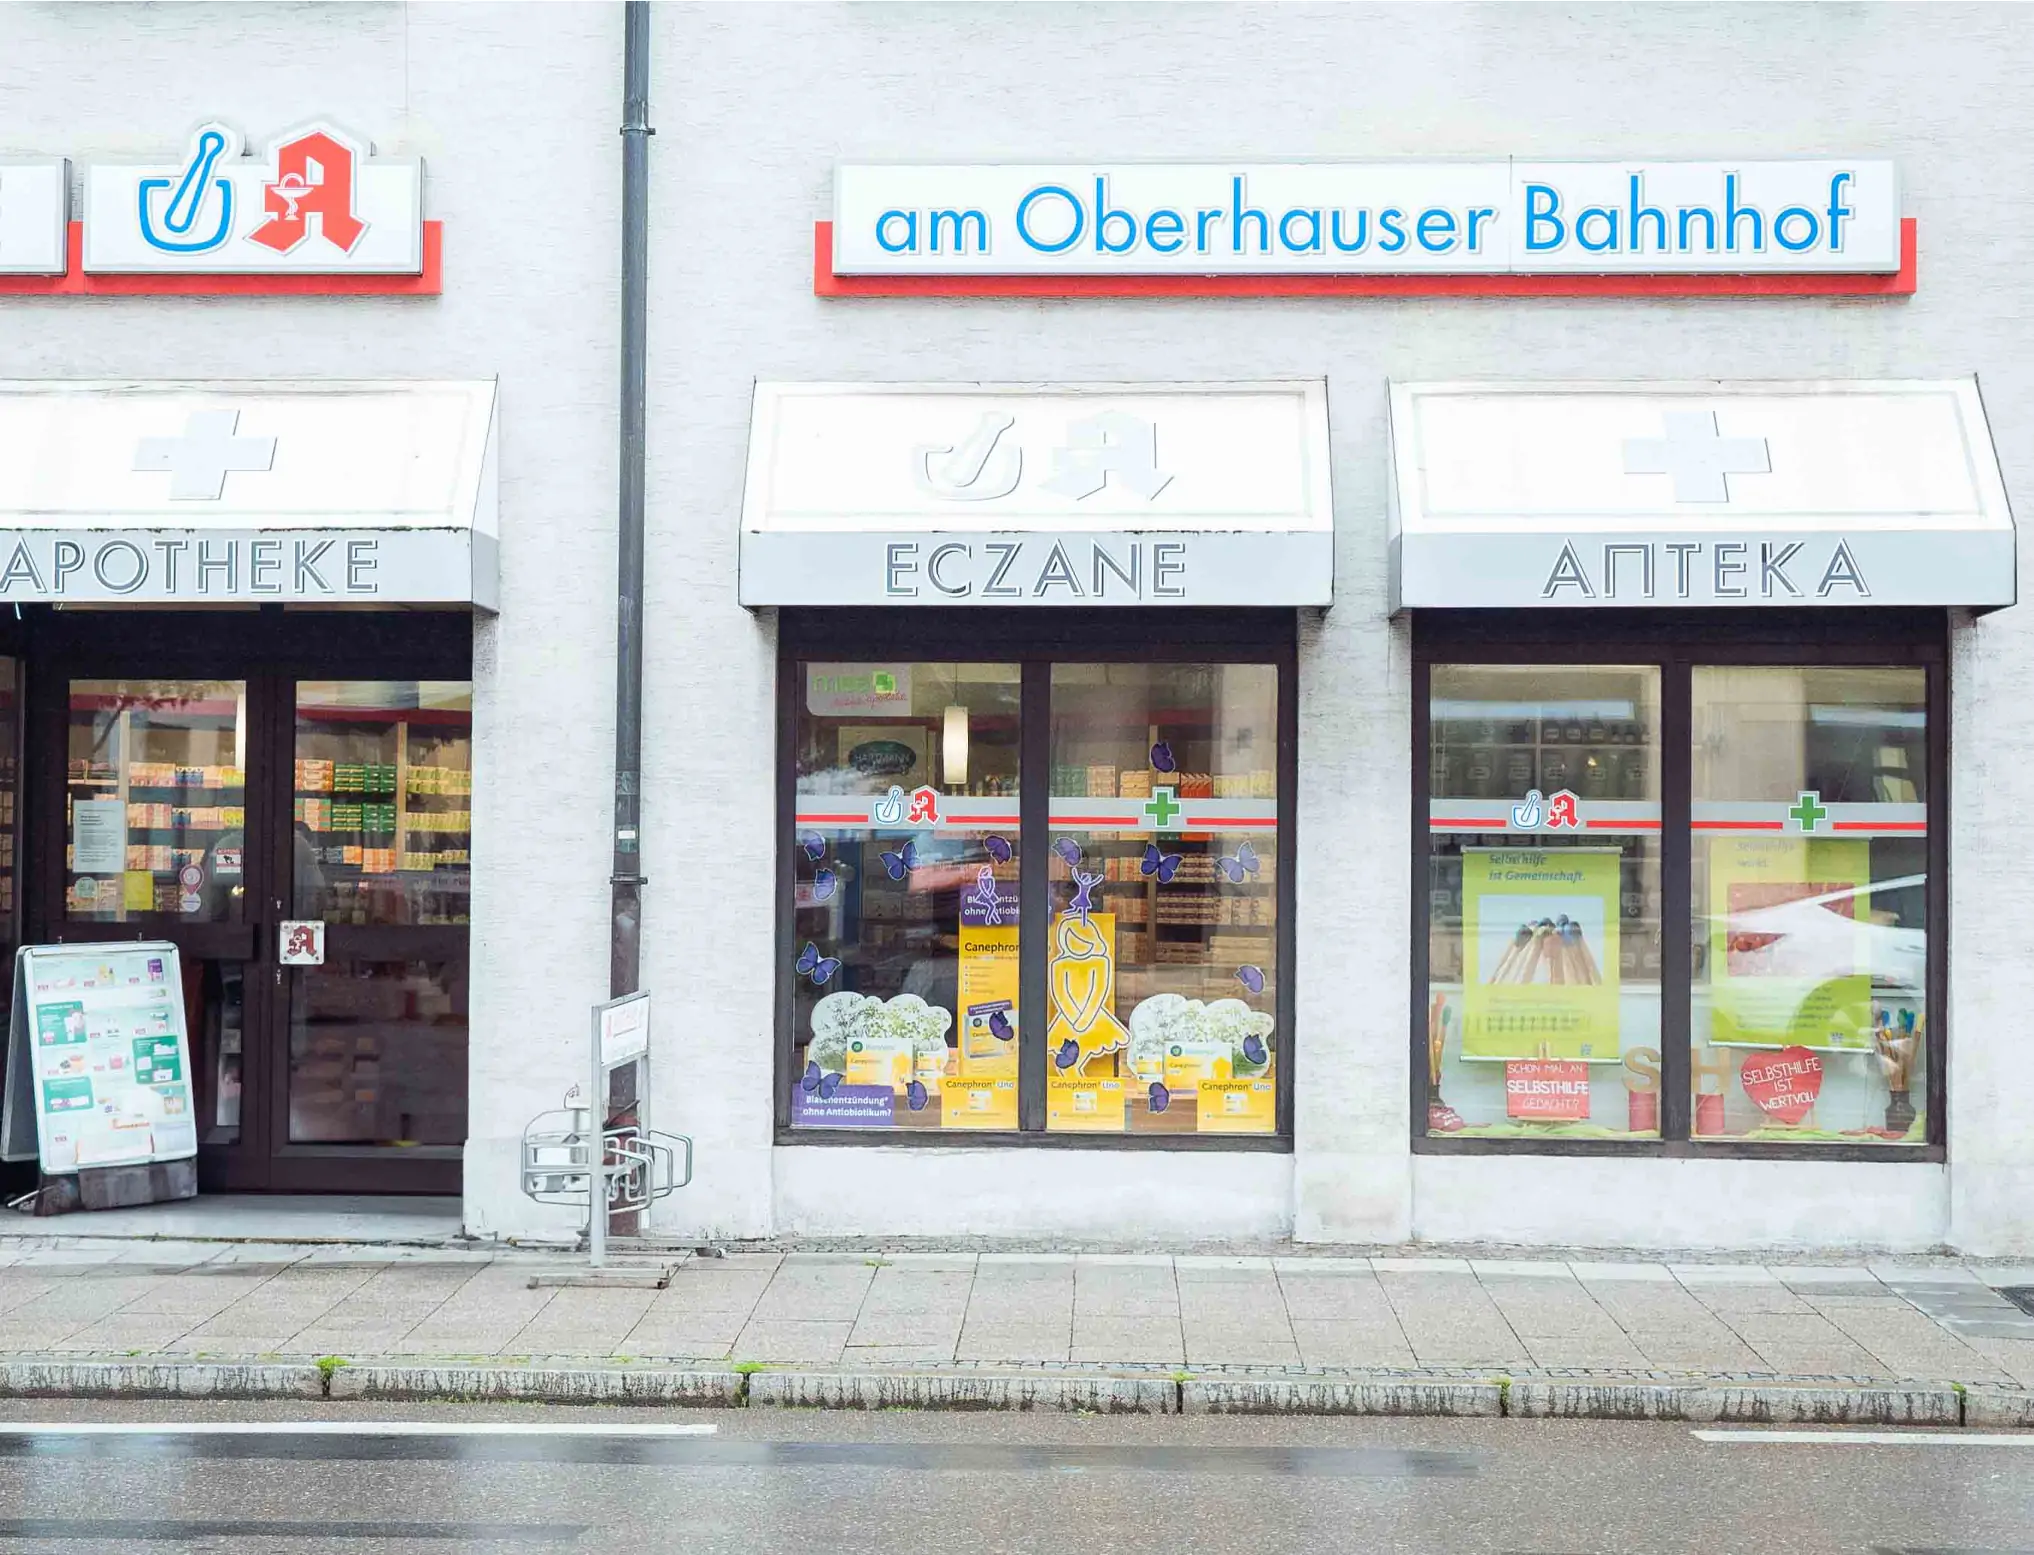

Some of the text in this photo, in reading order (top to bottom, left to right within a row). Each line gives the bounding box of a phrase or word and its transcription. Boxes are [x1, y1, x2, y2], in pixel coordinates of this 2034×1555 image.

[874, 171, 1856, 254] am Oberhauser Bahnhof
[0, 536, 377, 594] APOTHEKE
[884, 538, 1185, 600] ECZANE
[1540, 538, 1871, 598] АПТЕКА
[964, 907, 986, 916] ohne
[1507, 1063, 1541, 1074] SCHON
[1569, 1065, 1583, 1074] AN
[1743, 1057, 1822, 1085] SELBSTHILFE
[1506, 1080, 1589, 1096] SELBSTHILFE
[1773, 1077, 1793, 1092] IST
[802, 1107, 825, 1116] ohne
